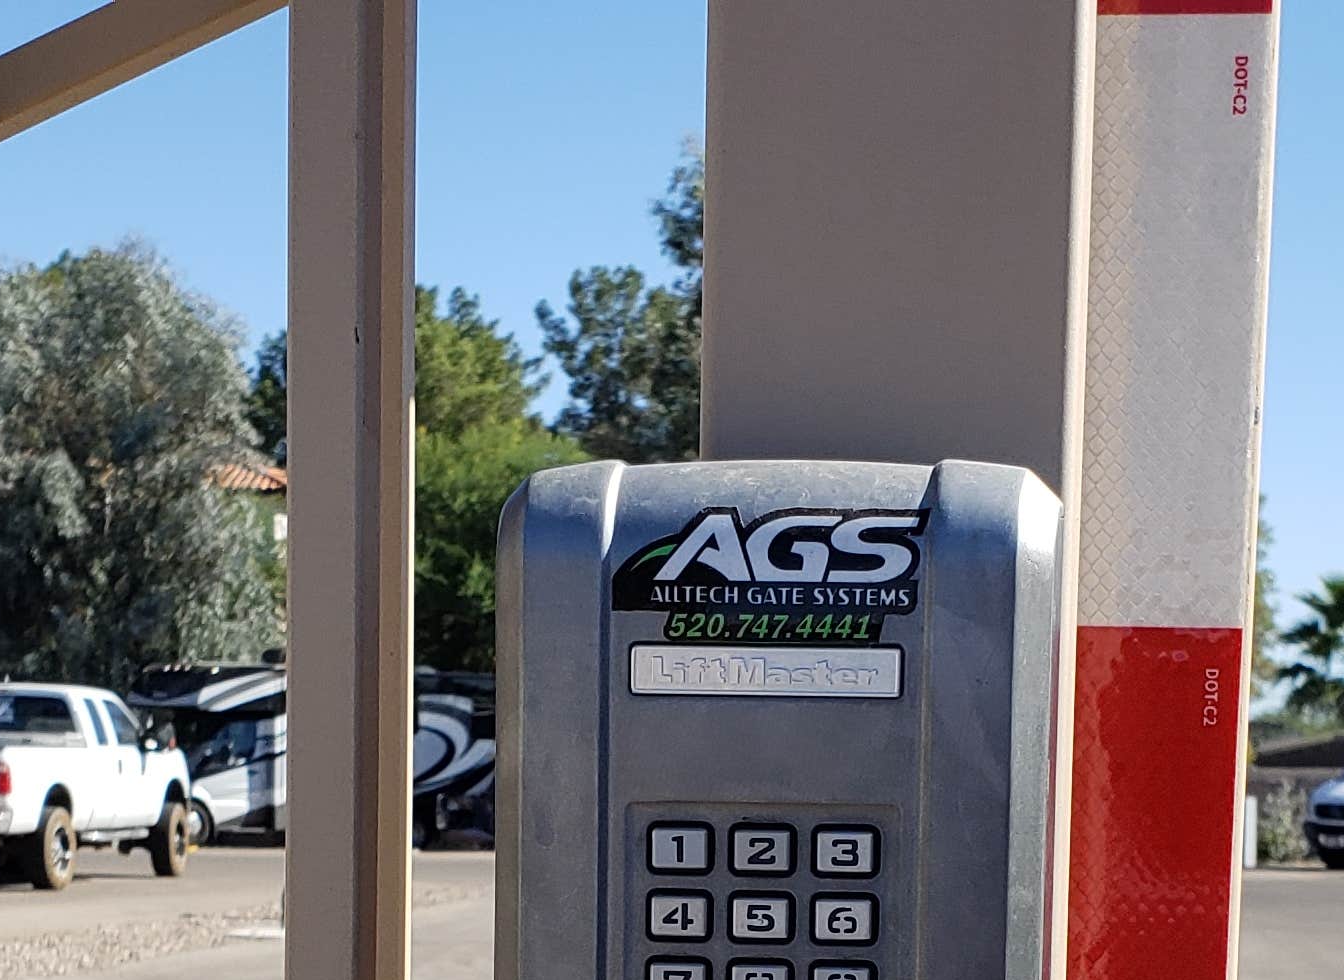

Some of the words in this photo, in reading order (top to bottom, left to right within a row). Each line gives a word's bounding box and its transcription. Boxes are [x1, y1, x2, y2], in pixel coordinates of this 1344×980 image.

[1232, 55, 1249, 115] DOT-C2
[652, 513, 920, 583] AGS
[650, 585, 738, 604] ALLTECH
[747, 587, 804, 605] GATE
[813, 588, 910, 607] SYSTEMS
[668, 612, 872, 639] 520.747.4441
[651, 655, 879, 686] LiftMaster
[1203, 668, 1219, 727] DOT-C2
[671, 835, 685, 863] 1
[747, 837, 776, 865] 2
[830, 838, 859, 866] 3
[662, 902, 694, 931] 4
[746, 904, 775, 932] 5
[827, 907, 857, 934] 6
